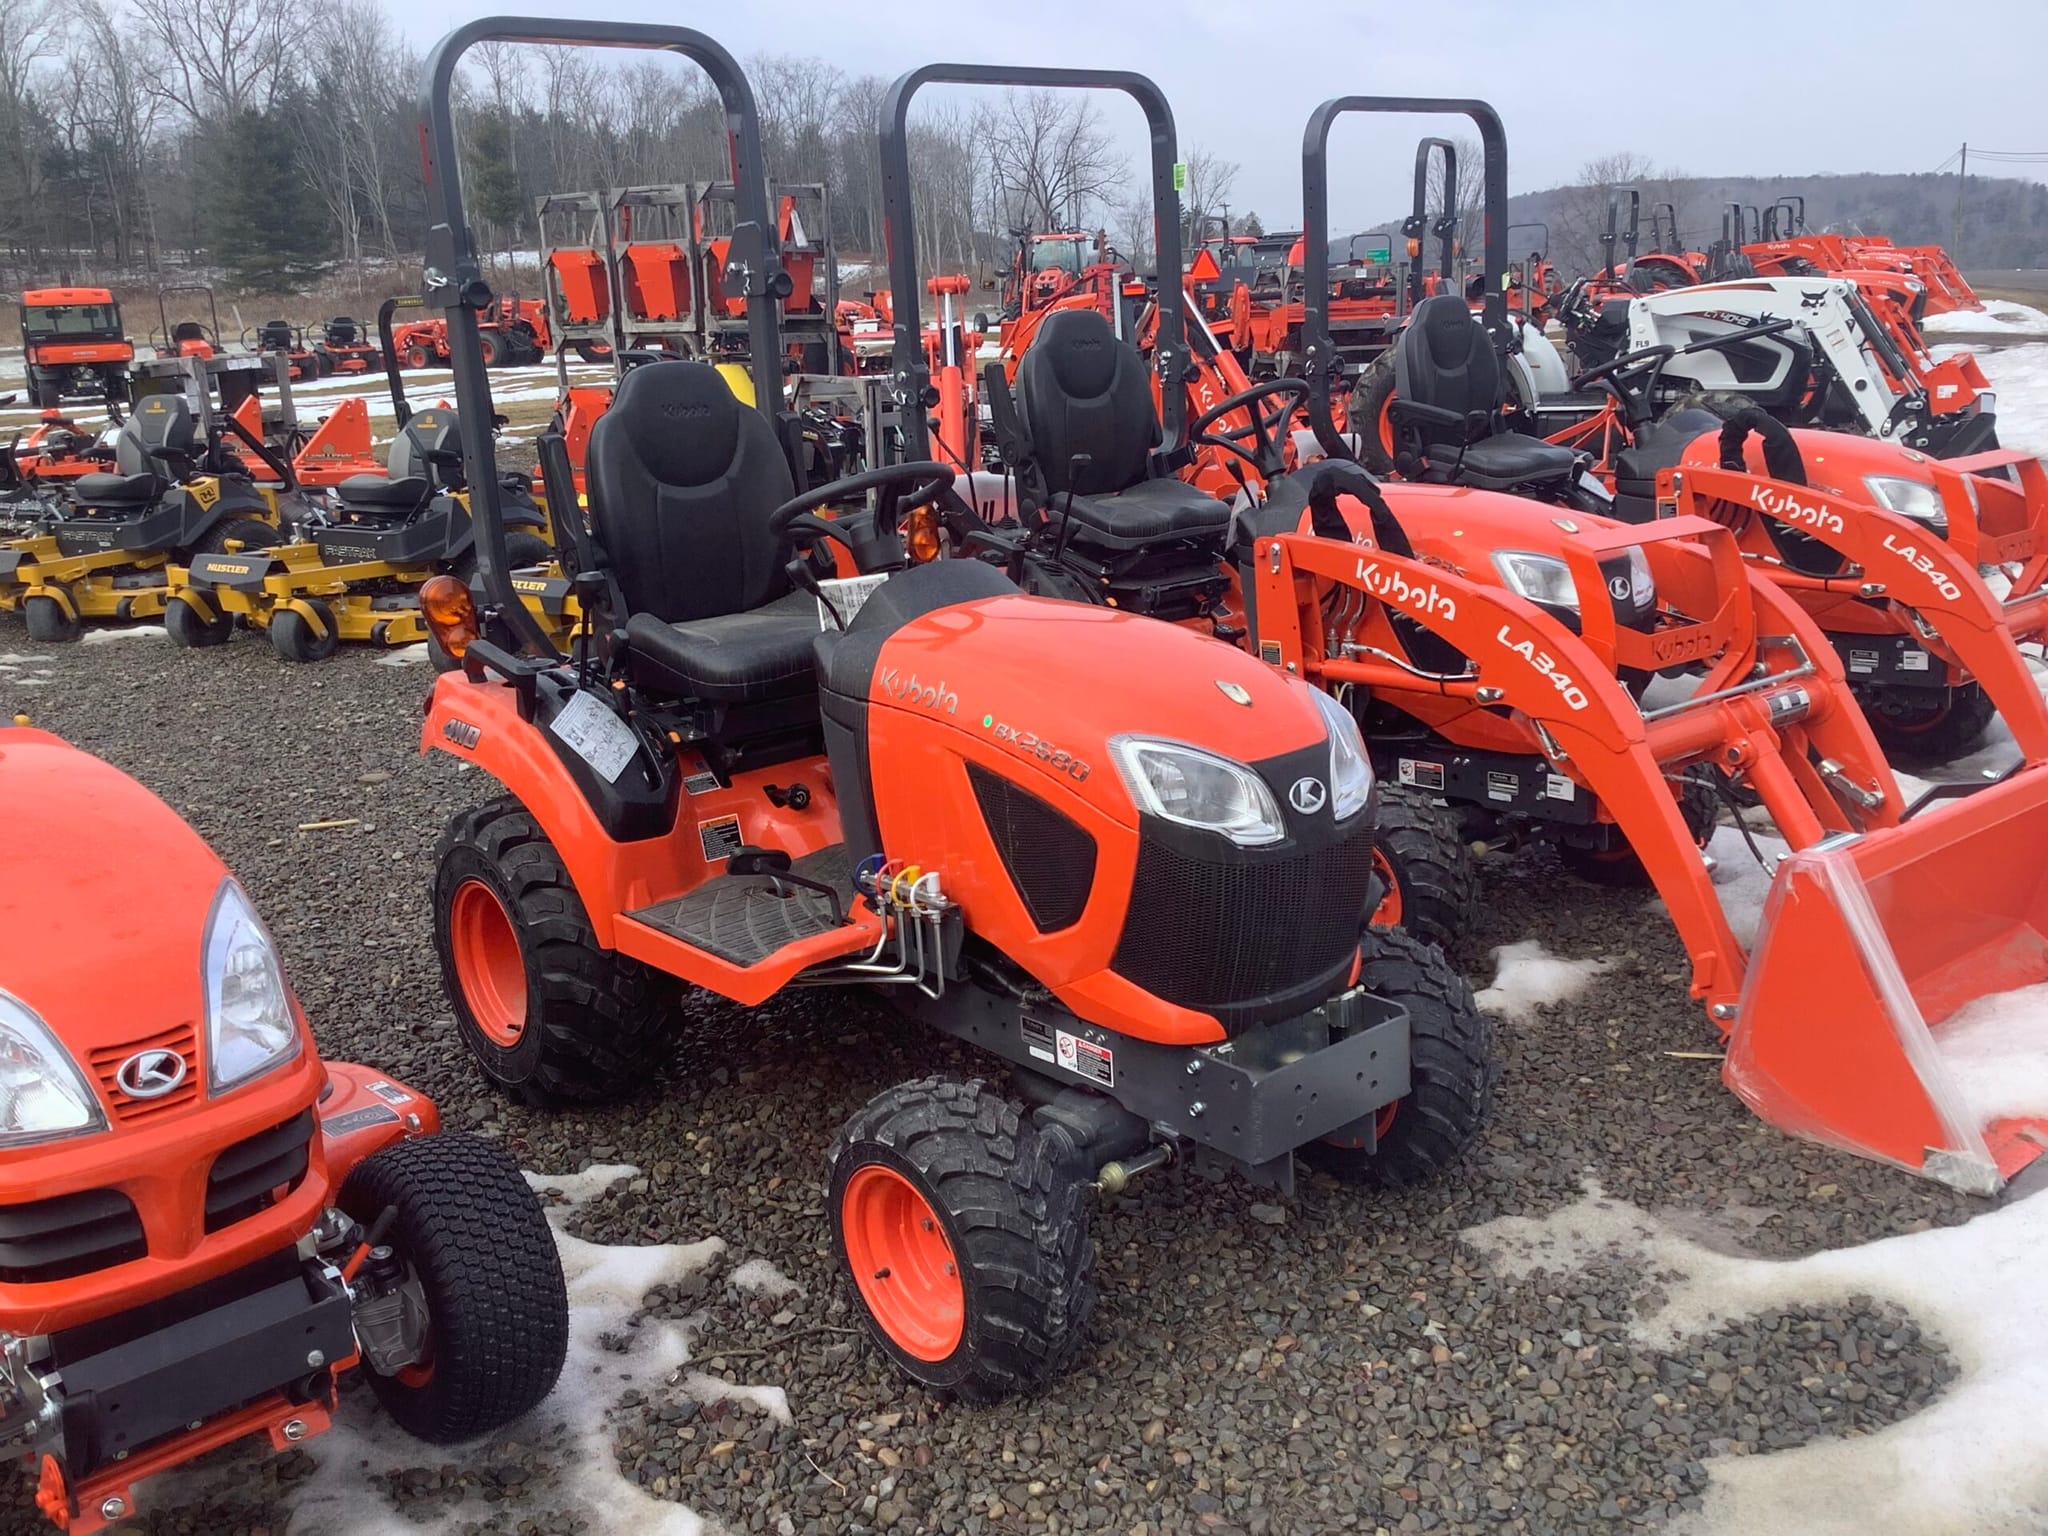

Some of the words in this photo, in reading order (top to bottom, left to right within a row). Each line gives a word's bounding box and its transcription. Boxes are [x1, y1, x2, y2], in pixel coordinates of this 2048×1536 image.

[1751, 484, 1844, 534] Kubota
[61, 530, 116, 542] FASTRAK
[324, 544, 377, 559] FASTRAK
[206, 562, 250, 574] HUSTLER
[511, 580, 547, 591] STLER
[1882, 534, 1962, 600] LA340
[1356, 558, 1457, 621] Kubota
[1651, 630, 1711, 661] Kubota
[1496, 625, 1589, 711] LA340
[880, 666, 958, 714] Kubota
[444, 717, 481, 749] 4WD
[993, 722, 1091, 782] BX2680
